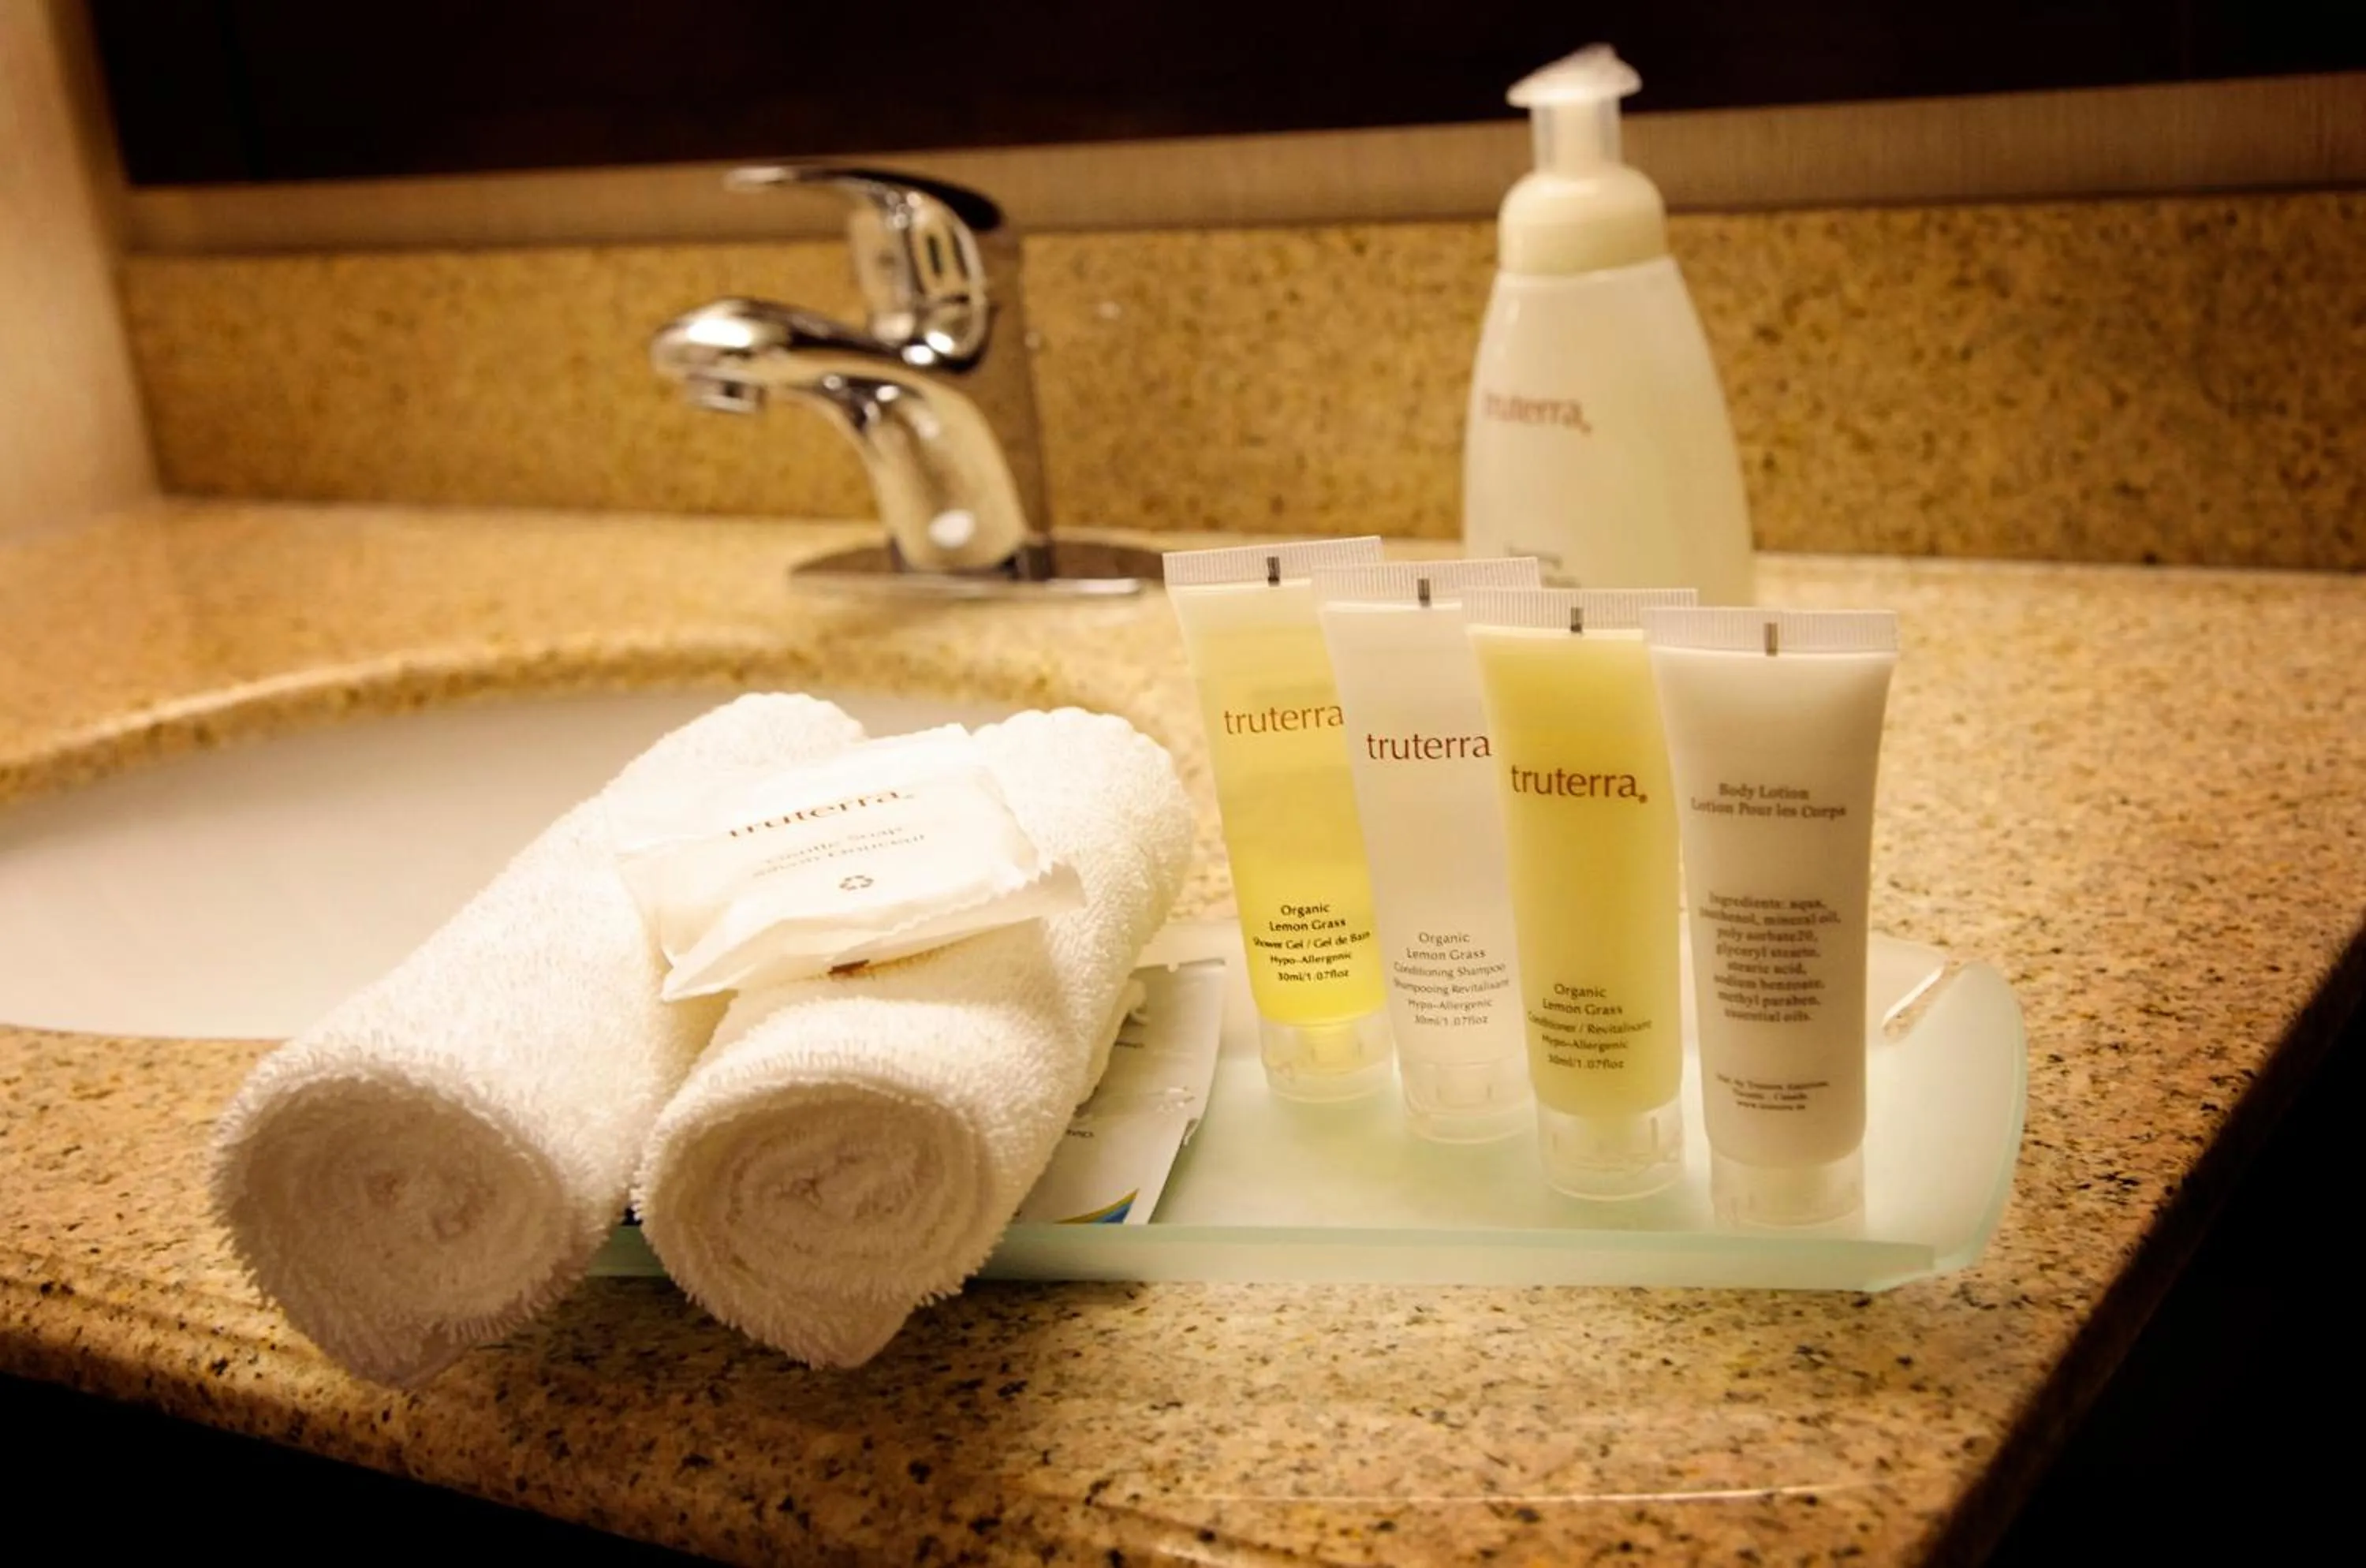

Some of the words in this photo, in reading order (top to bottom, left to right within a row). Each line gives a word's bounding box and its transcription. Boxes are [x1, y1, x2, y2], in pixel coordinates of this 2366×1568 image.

[1224, 704, 1344, 734] truterra
[1367, 734, 1492, 760] truterra
[1719, 782, 1755, 800] Body
[1759, 785, 1809, 801] Lotion
[1691, 796, 1733, 815] Lotion
[1738, 802, 1773, 816] Pour
[1776, 803, 1797, 817] les
[1801, 805, 1846, 821] Corps
[1280, 903, 1330, 918] Organic
[1269, 920, 1308, 932] Lemon
[1312, 918, 1346, 931] Grass
[1286, 939, 1304, 950] Gel
[1313, 937, 1333, 949] Gel
[1335, 935, 1348, 946] de
[1418, 931, 1472, 946] Organic
[1270, 951, 1352, 967] Hypo-Allergenic
[1406, 947, 1446, 961] Lemon
[1449, 948, 1487, 961] Grass
[1394, 961, 1455, 978] Conditioning
[1457, 962, 1506, 976] Shampoo
[1554, 982, 1608, 1000] Organic
[1408, 998, 1493, 1011] Hypo-Allergenic
[1542, 998, 1581, 1014] Lemon
[1584, 1003, 1624, 1016] Grass
[1541, 1034, 1629, 1053] Hypo-Allergenic
